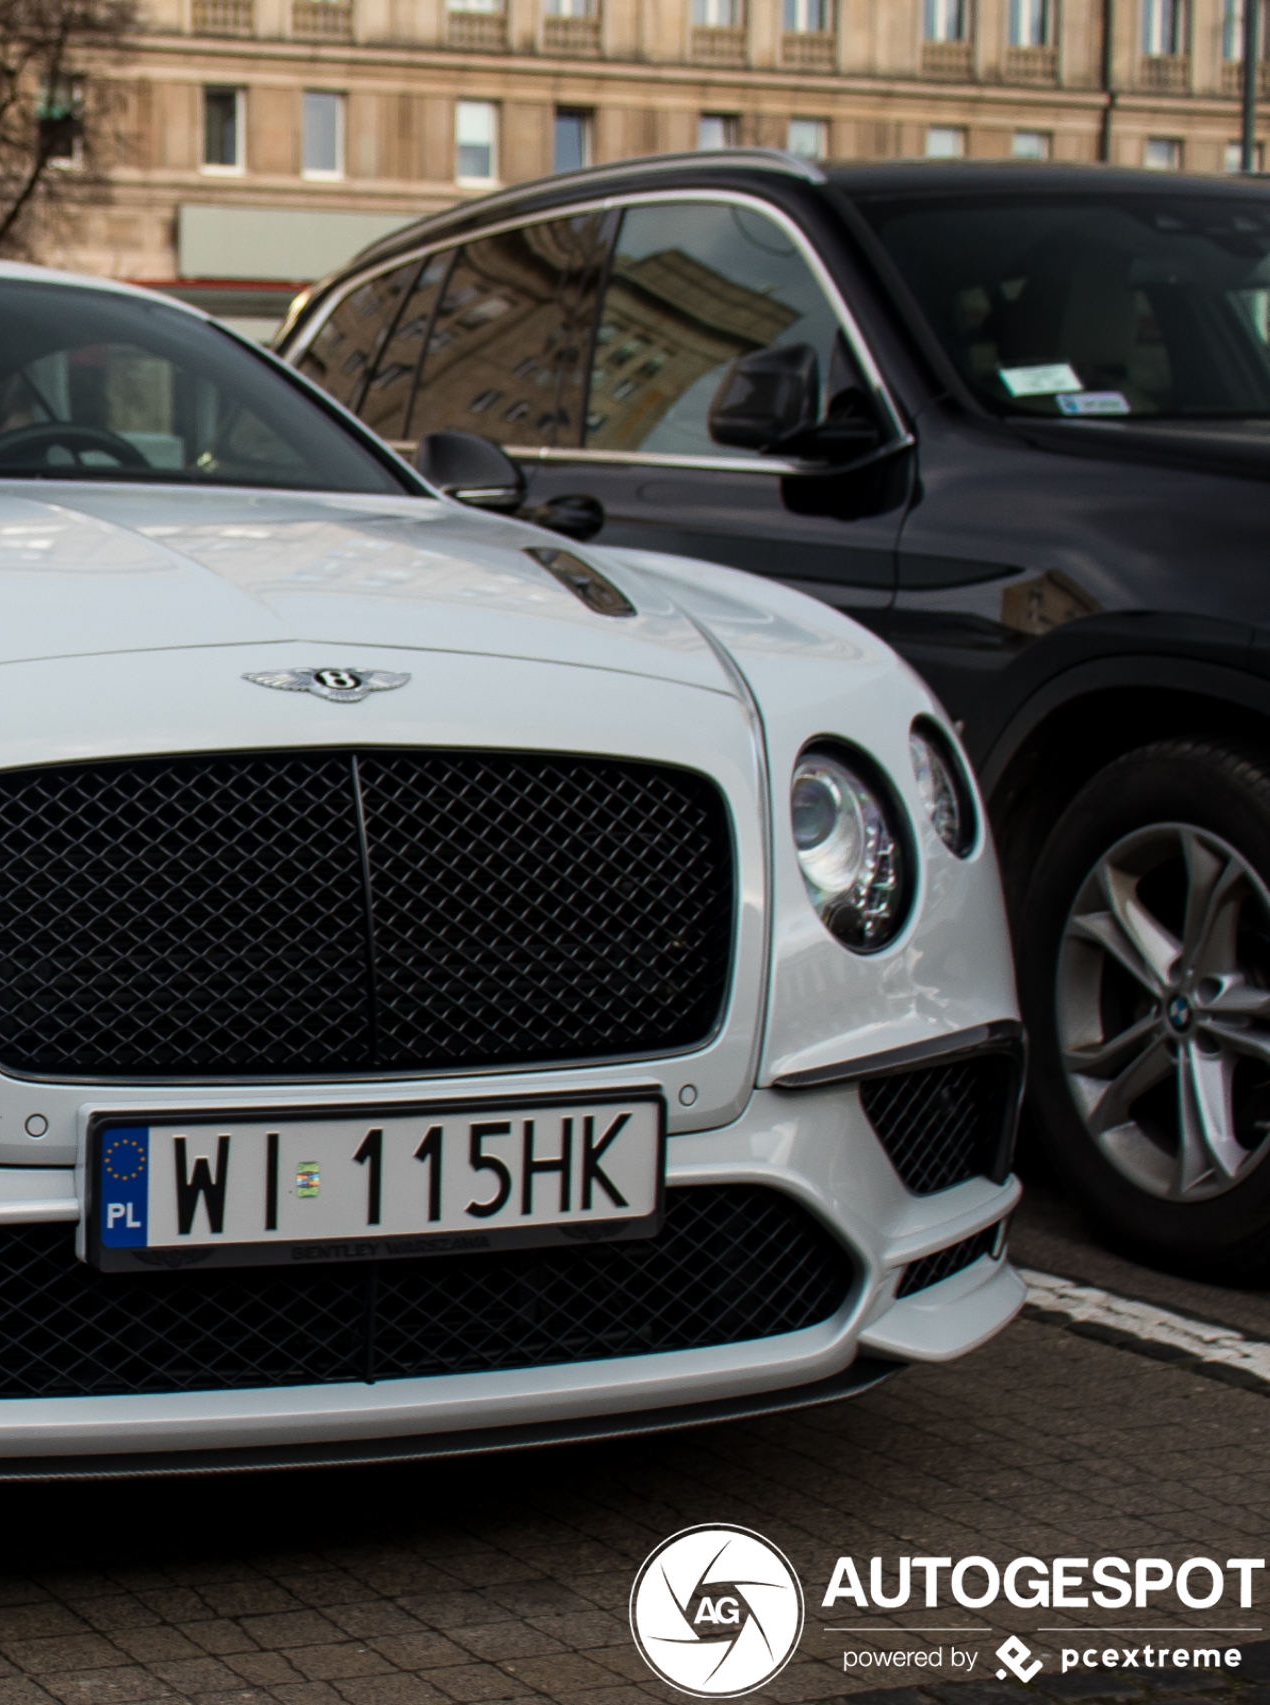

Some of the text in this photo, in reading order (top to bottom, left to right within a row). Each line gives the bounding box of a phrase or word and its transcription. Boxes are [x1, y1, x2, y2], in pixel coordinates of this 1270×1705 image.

[351, 1111, 633, 1226] 115HK
[107, 1202, 141, 1229] PL
[291, 1234, 491, 1260] BENTLEY WARSZAWA
